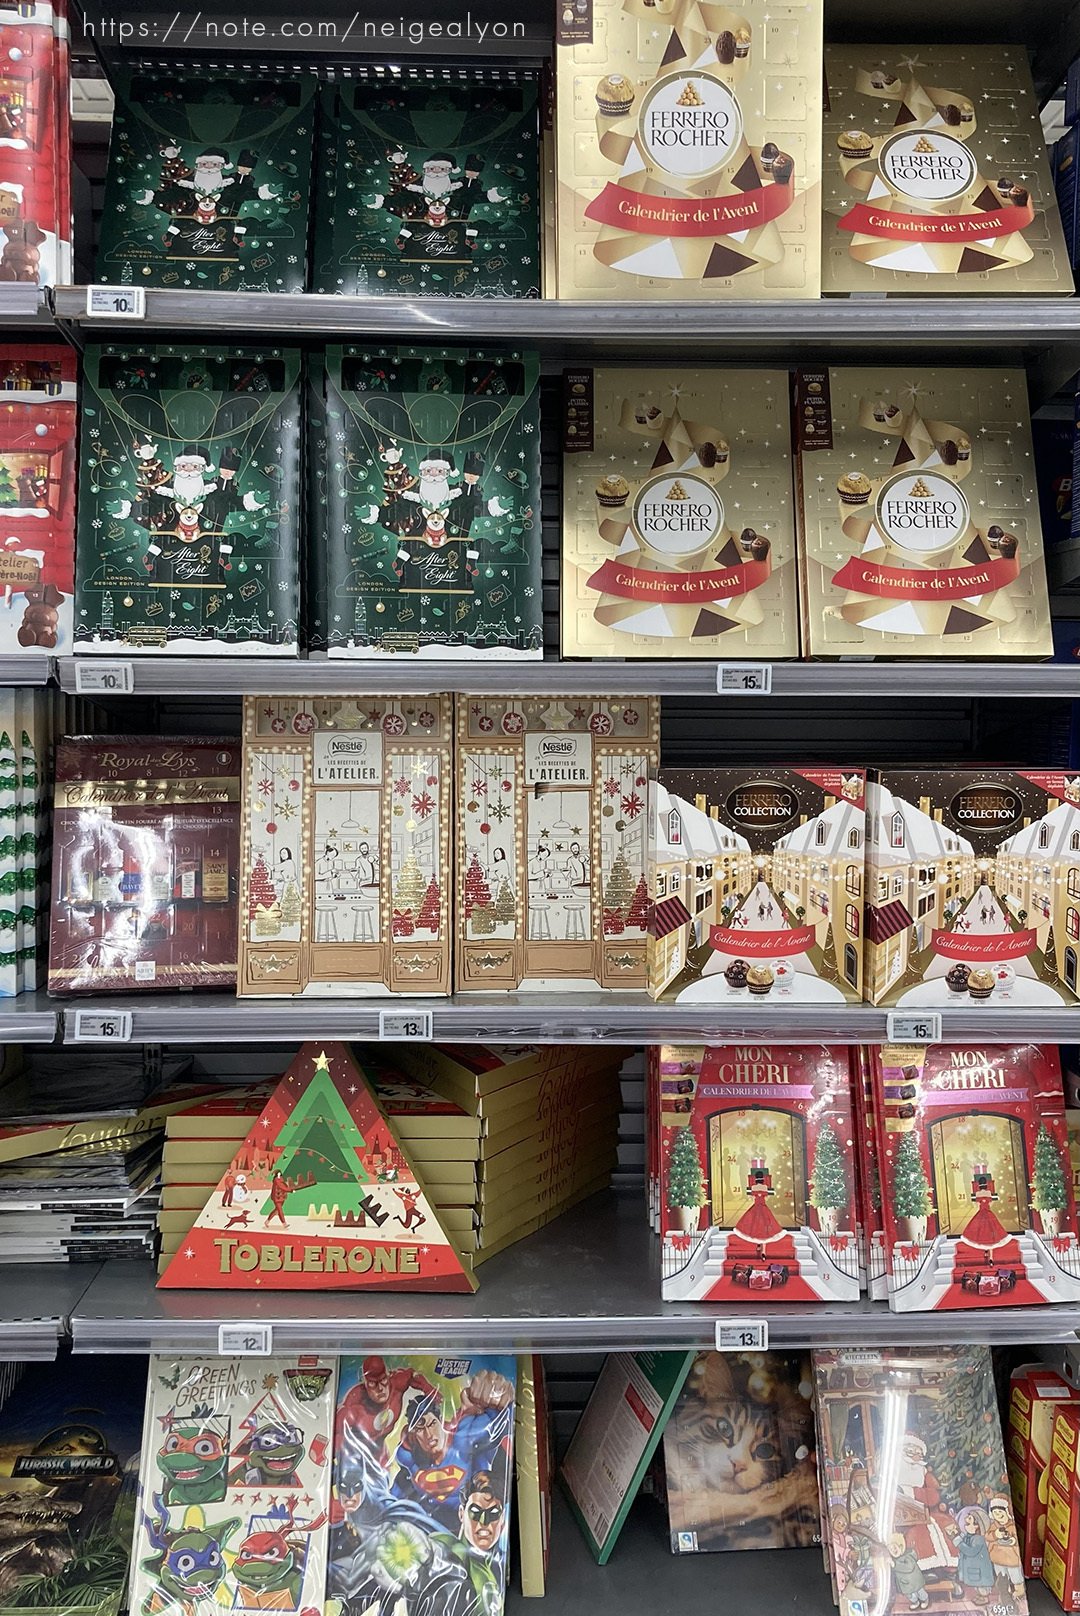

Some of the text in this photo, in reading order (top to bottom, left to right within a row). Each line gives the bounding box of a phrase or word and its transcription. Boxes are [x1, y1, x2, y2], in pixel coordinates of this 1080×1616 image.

[651, 111, 729, 129] FERRERO
[651, 130, 729, 147] ROCHER
[890, 156, 964, 168] FERRERO
[892, 168, 966, 180] ROCHER
[618, 200, 759, 223] Calendrier de l'Avent
[868, 215, 1004, 233] Calendrier de l'Avent
[180, 228, 216, 241] After
[412, 230, 448, 244] After
[191, 241, 224, 254] Eight
[425, 244, 457, 256] Eight
[113, 298, 128, 312] 10
[644, 504, 712, 517] FERRERO
[887, 501, 957, 515] FERRERO
[644, 518, 712, 532] ROCHER
[888, 515, 959, 529] ROCHER
[162, 546, 200, 561] After
[410, 552, 448, 566] After
[175, 562, 210, 579] Eight
[424, 567, 459, 585] Eight
[615, 573, 741, 592] Calendrier de l'Avent
[862, 570, 991, 589] Calendrier de l'Avent
[101, 675, 116, 688] 10
[742, 676, 756, 689] 15
[332, 742, 363, 752] Nestlé
[542, 742, 573, 752] Nestlé
[100, 752, 150, 770] Royal
[157, 752, 196, 772] Lys
[735, 794, 792, 806] FERRERO
[960, 796, 1015, 810] FERRERO
[211, 806, 222, 814] 13
[734, 807, 792, 816] COLLECTION
[958, 810, 1015, 819] COLLECTION
[210, 849, 220, 857] 14
[714, 932, 760, 948] Calendrier
[761, 940, 773, 948] de
[936, 936, 982, 952] Calendrier
[983, 943, 994, 952] de
[178, 951, 189, 959] 16
[100, 1022, 114, 1036] 15
[402, 1022, 417, 1036] 13
[913, 1024, 926, 1038] 15
[734, 1047, 772, 1062] MON
[798, 1054, 803, 1062] 3
[950, 1050, 988, 1068] MON
[703, 1087, 759, 1096] CALENDRIER
[798, 1102, 803, 1110] 6
[727, 1155, 737, 1163] 24
[951, 1162, 960, 1170] 24
[213, 1238, 420, 1274] TOBLERONE
[690, 1274, 695, 1282] 9
[823, 1273, 830, 1281] 13
[921, 1284, 926, 1292] 9
[242, 1338, 256, 1350] 12
[739, 1332, 754, 1346] 13
[438, 1360, 469, 1368] JUSTICE
[188, 1363, 240, 1386] GREEN
[442, 1366, 467, 1376] LEAGUE
[176, 1380, 257, 1408] GREETINGS
[18, 1457, 114, 1470] JURASSIC WORLD
